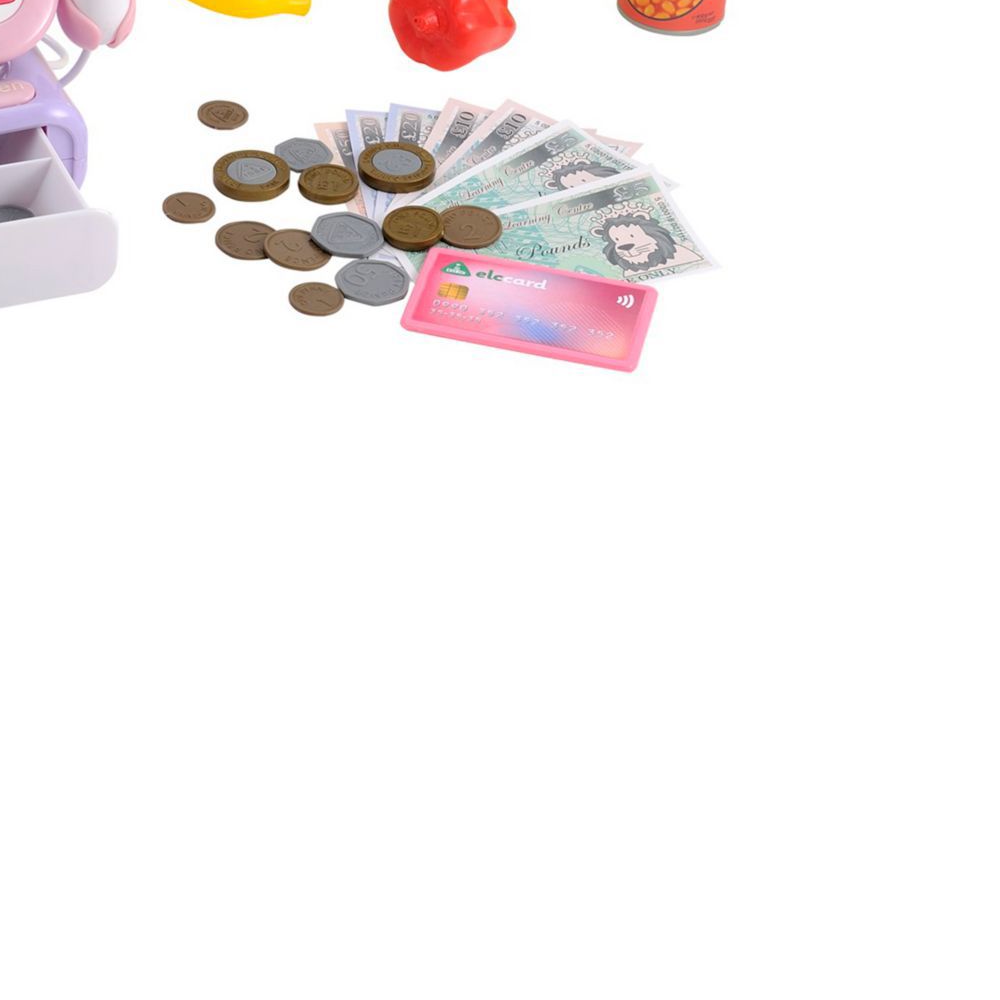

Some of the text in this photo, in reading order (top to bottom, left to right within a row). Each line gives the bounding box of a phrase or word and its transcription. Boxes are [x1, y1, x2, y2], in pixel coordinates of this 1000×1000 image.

[361, 117, 381, 145] £20
[401, 112, 419, 142] £20
[450, 110, 475, 139] £10
[495, 112, 528, 140] £10
[545, 132, 578, 152] £5
[613, 181, 650, 201] £5
[557, 202, 592, 217] Centre
[516, 236, 592, 260] Pounds
[638, 267, 677, 282] ONLY
